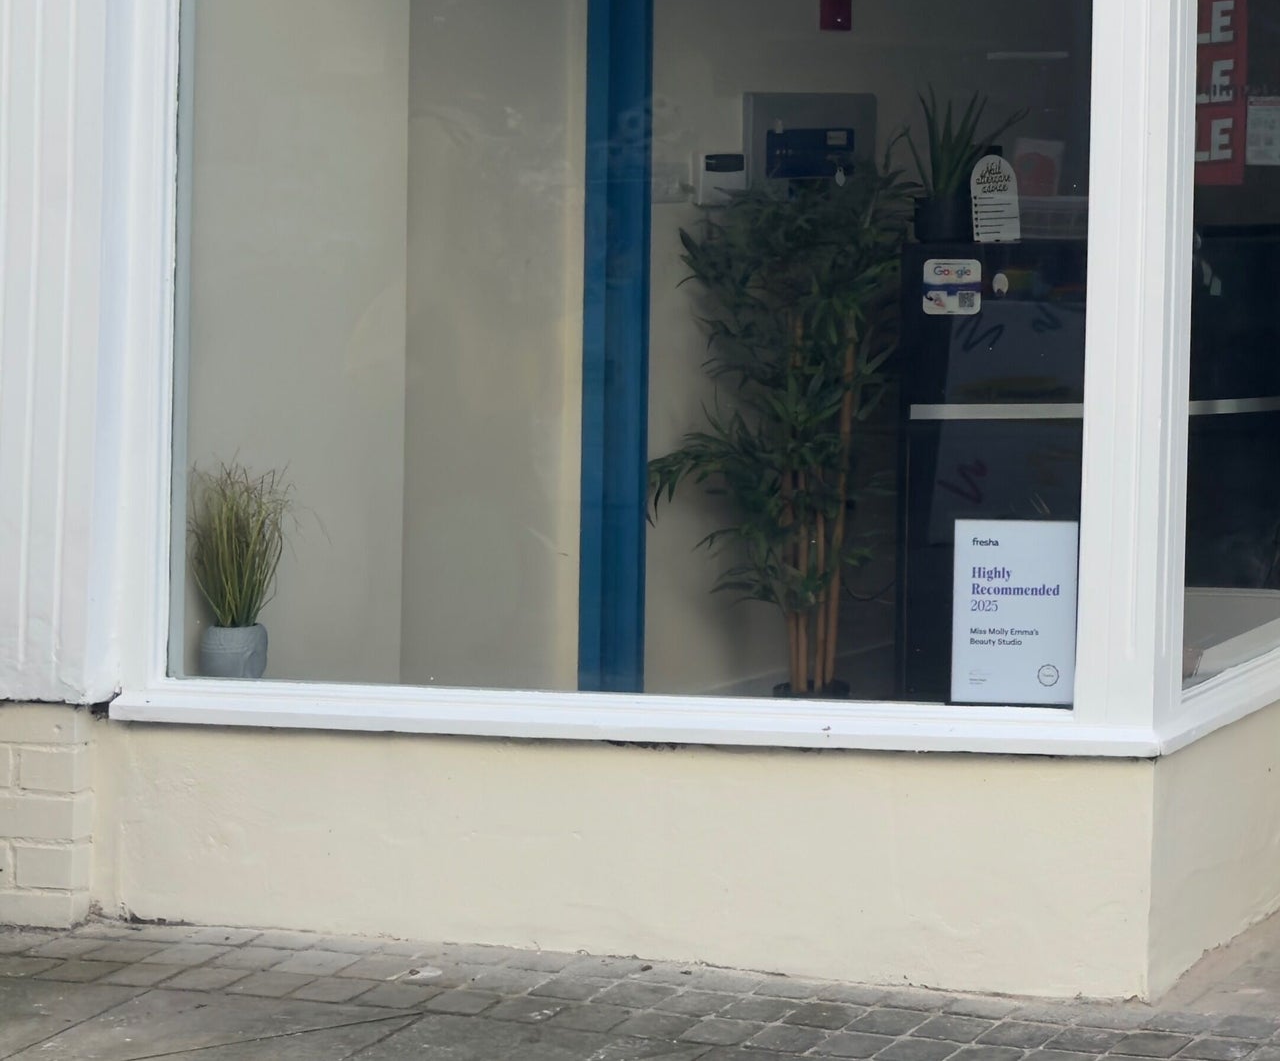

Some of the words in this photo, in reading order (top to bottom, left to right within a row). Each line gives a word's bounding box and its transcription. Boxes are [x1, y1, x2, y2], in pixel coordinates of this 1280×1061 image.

[972, 537, 999, 547] fresha
[971, 566, 1012, 582] Highly
[971, 583, 1060, 596] Recommended
[970, 599, 999, 612] 2025
[969, 628, 987, 636] Miss
[988, 628, 1009, 637] Molly
[1010, 628, 1039, 636] Emma's
[969, 638, 996, 647] Beauty
[997, 638, 1023, 646] Studio
